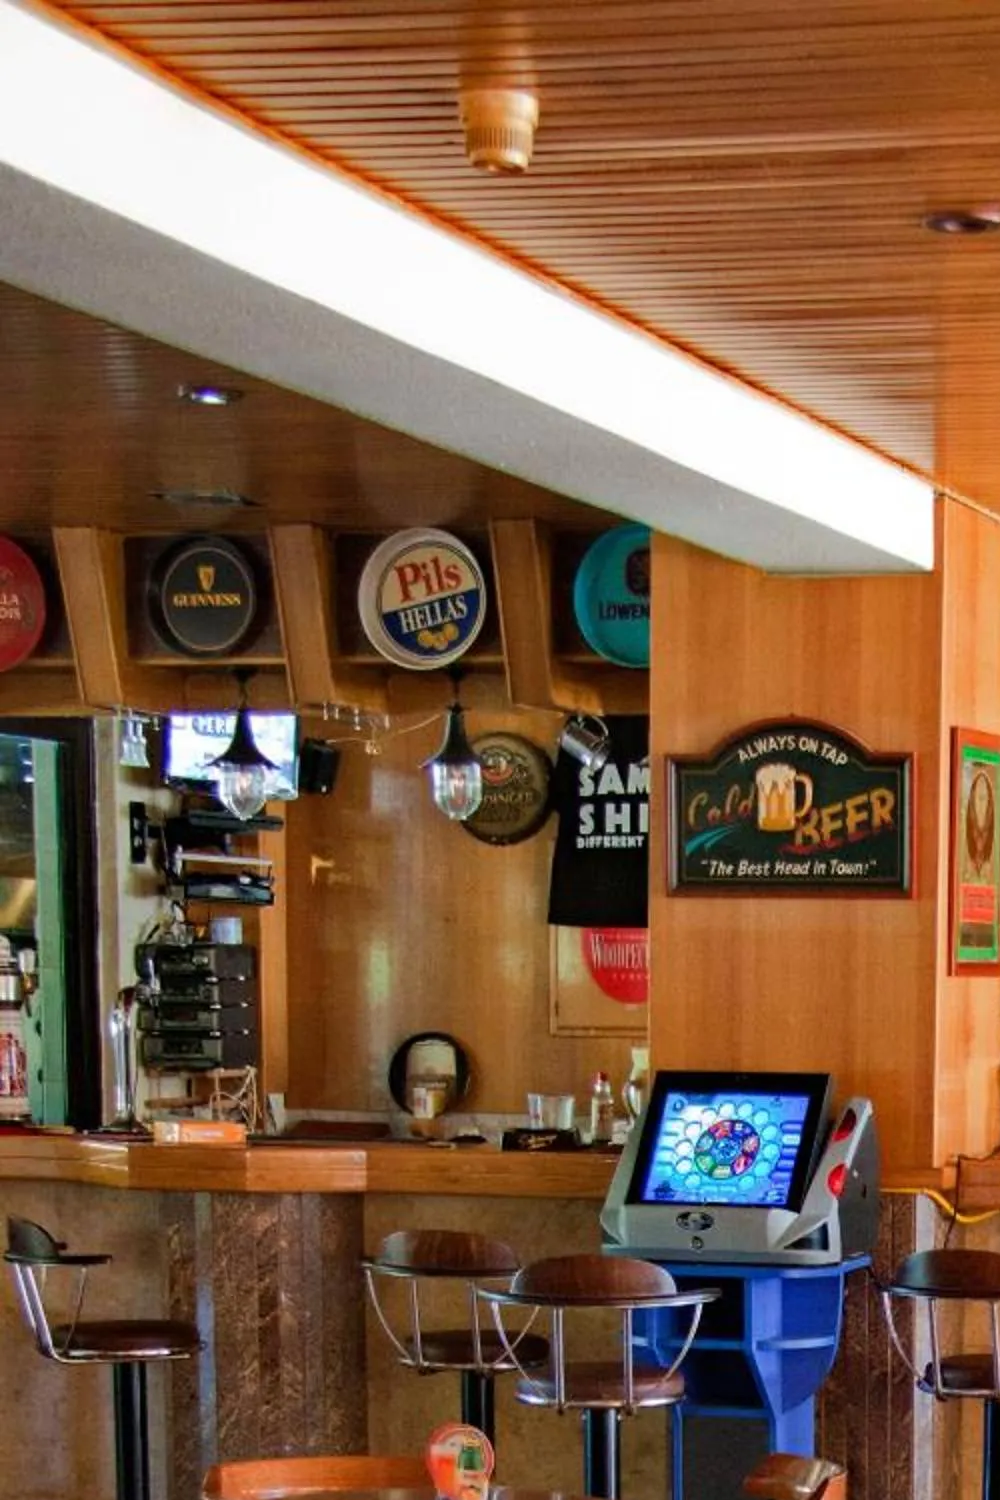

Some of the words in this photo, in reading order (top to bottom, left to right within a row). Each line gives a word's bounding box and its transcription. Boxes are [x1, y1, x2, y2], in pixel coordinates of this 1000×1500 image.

[394, 556, 463, 603] Pils
[173, 592, 241, 608] GUINNESS
[400, 595, 468, 635] HELLAS
[738, 735, 797, 763] ALWAYS
[799, 736, 819, 752] ON
[822, 742, 849, 766] TAP
[579, 763, 650, 796] SAM
[579, 803, 649, 834] SHI
[688, 783, 755, 828] Cold
[795, 786, 896, 846] BEER
[576, 836, 644, 848] DIFFERENT
[738, 859, 770, 876] Best
[774, 859, 810, 876] Head
